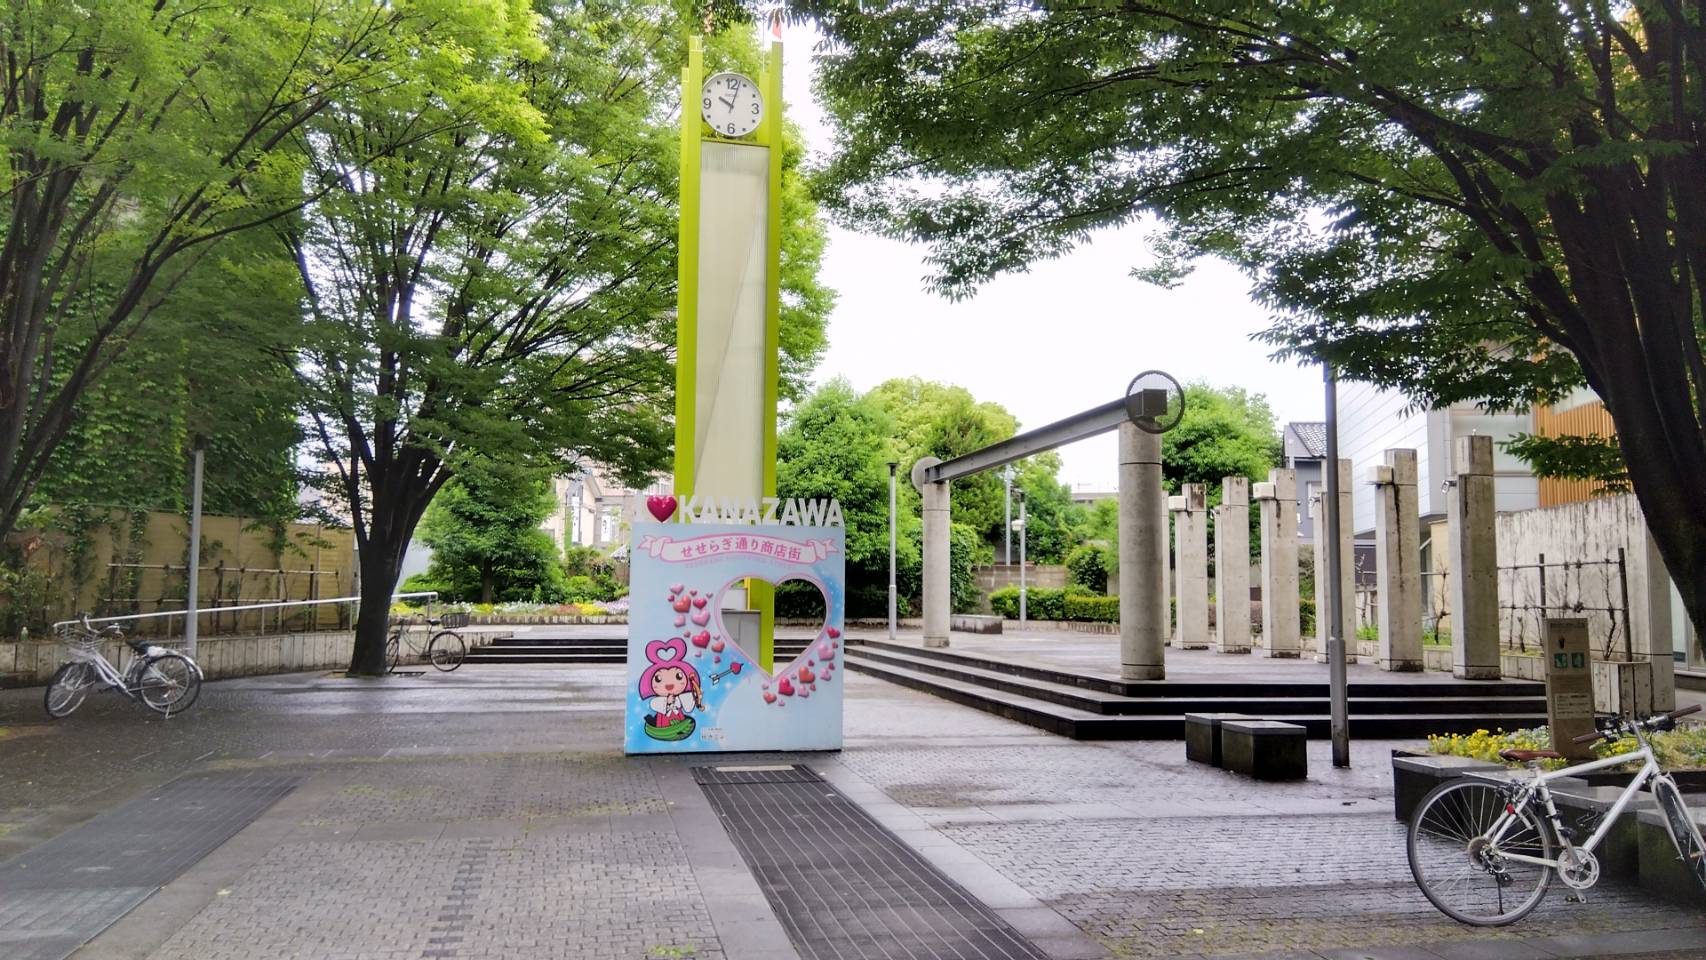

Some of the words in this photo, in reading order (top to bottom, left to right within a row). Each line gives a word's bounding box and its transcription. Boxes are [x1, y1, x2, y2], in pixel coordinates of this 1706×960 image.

[725, 78, 738, 89] 12
[703, 98, 712, 109] 9
[751, 103, 760, 114] 3
[727, 123, 736, 134] 6
[679, 495, 845, 527] KANAZAWA
[681, 536, 802, 561] せせらぎ通り商店街
